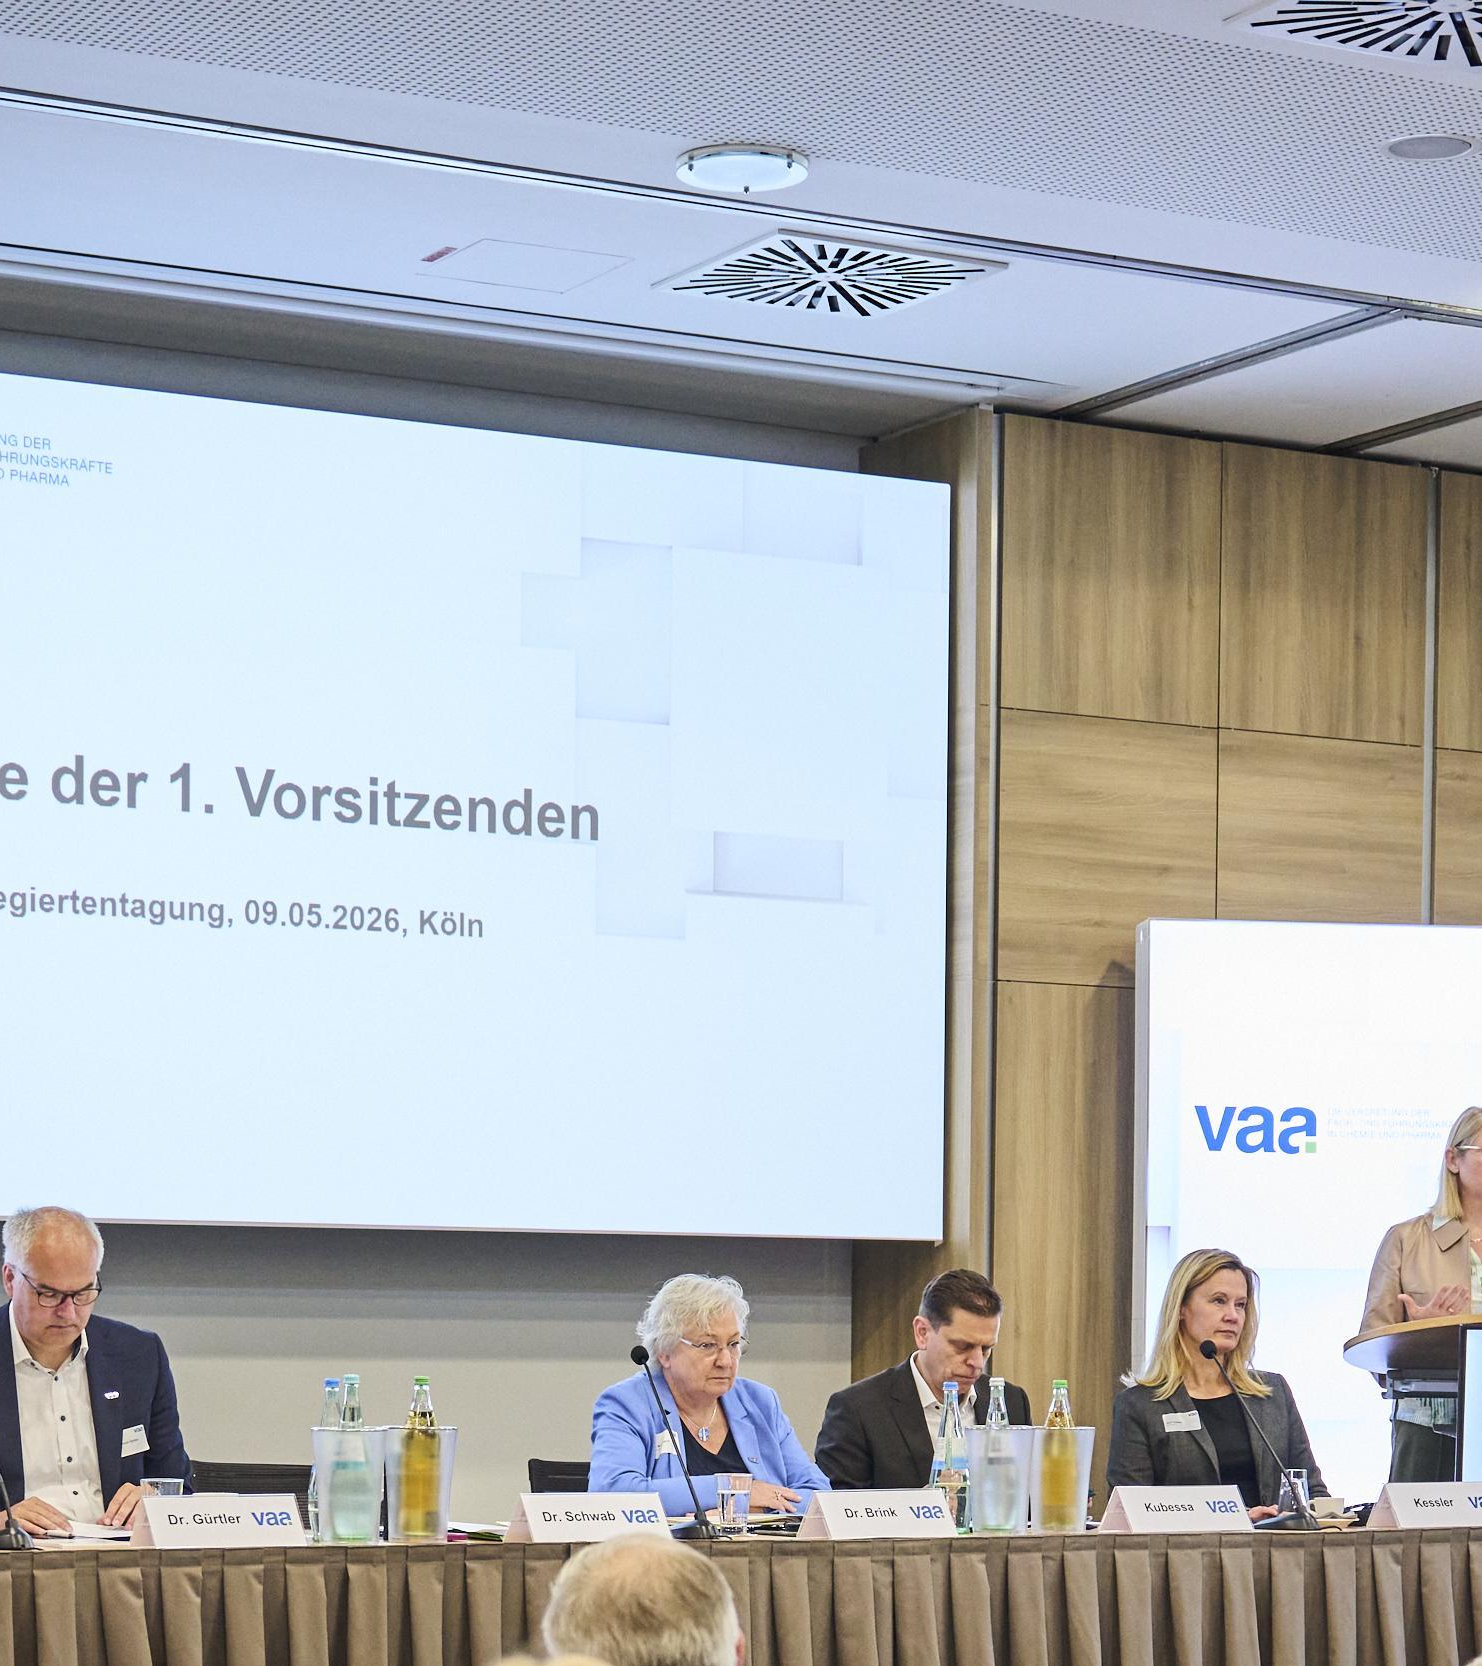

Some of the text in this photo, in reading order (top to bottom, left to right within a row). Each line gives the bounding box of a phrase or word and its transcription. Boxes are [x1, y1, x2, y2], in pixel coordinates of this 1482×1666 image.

[23, 435, 52, 451] DER
[9, 468, 71, 487] PHARMA
[51, 754, 149, 809] der
[169, 762, 214, 815] 1.
[234, 766, 599, 842] Vorsitzenden
[244, 899, 408, 938] 09.05.2026,
[419, 906, 483, 938] Köln
[1144, 1502, 1195, 1513] Kubessa
[1413, 1497, 1454, 1508] Kessler
[167, 1514, 189, 1525] Dr.
[192, 1512, 241, 1525] Gürtler
[542, 1511, 562, 1522] Dr.
[564, 1510, 616, 1522] Schwab
[844, 1508, 863, 1519] Dr.
[865, 1507, 898, 1518] Brink
